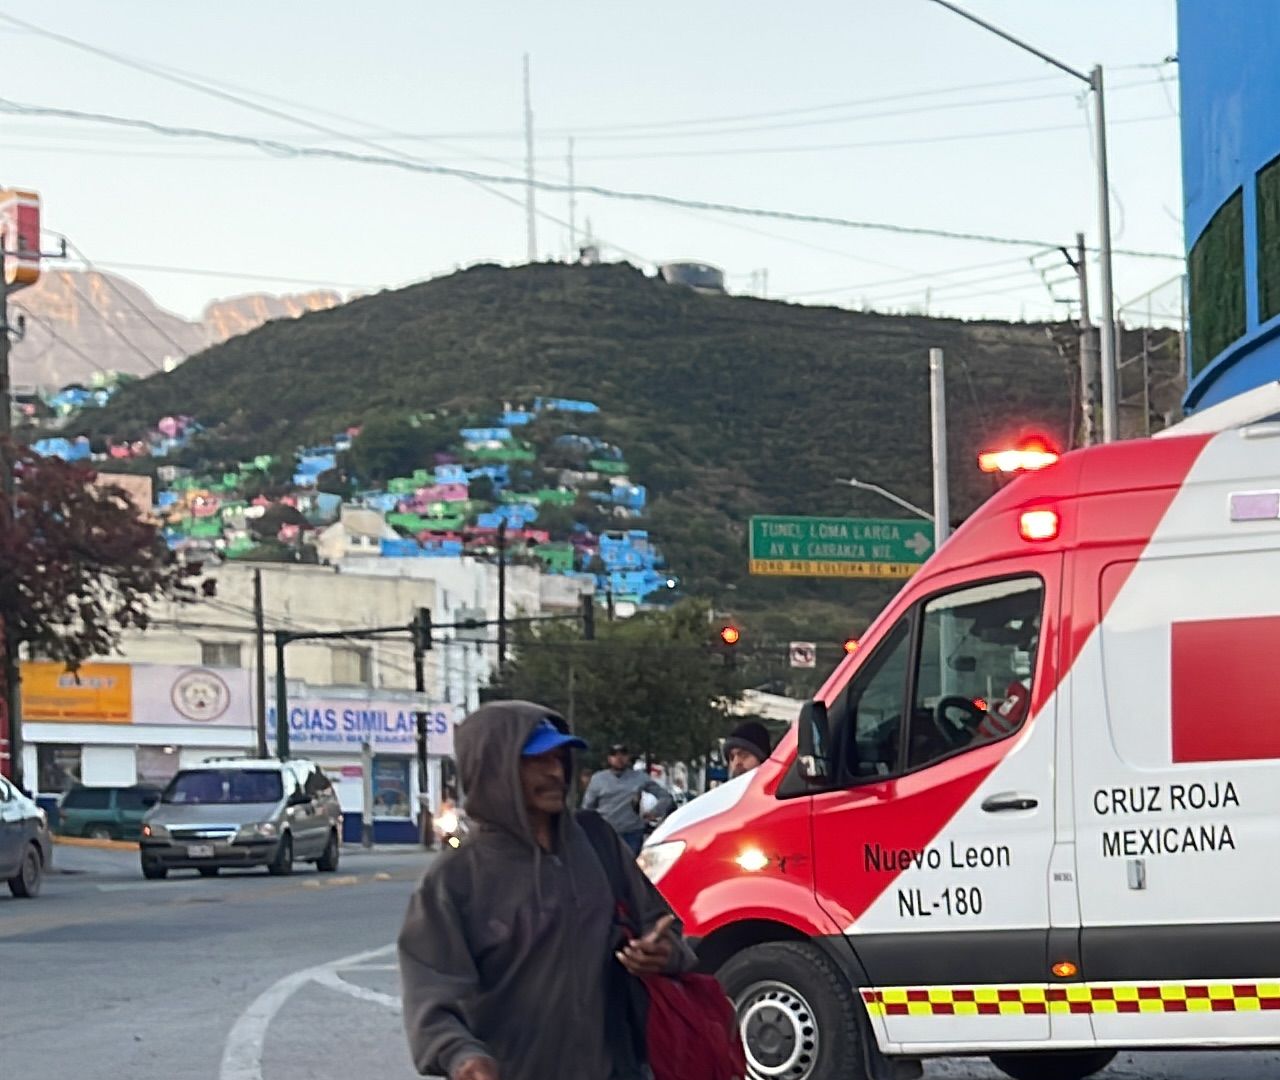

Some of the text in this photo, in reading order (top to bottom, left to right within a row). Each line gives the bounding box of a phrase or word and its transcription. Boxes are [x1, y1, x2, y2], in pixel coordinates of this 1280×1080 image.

[761, 522, 900, 540] TUNEL LOMA LARGA
[807, 543, 866, 558] CARRANZA
[1094, 781, 1240, 815] CRUZ ROJA
[1102, 824, 1236, 857] MEXICANA
[864, 841, 1010, 872] Nuevo Leon
[898, 886, 983, 917] NL-180
